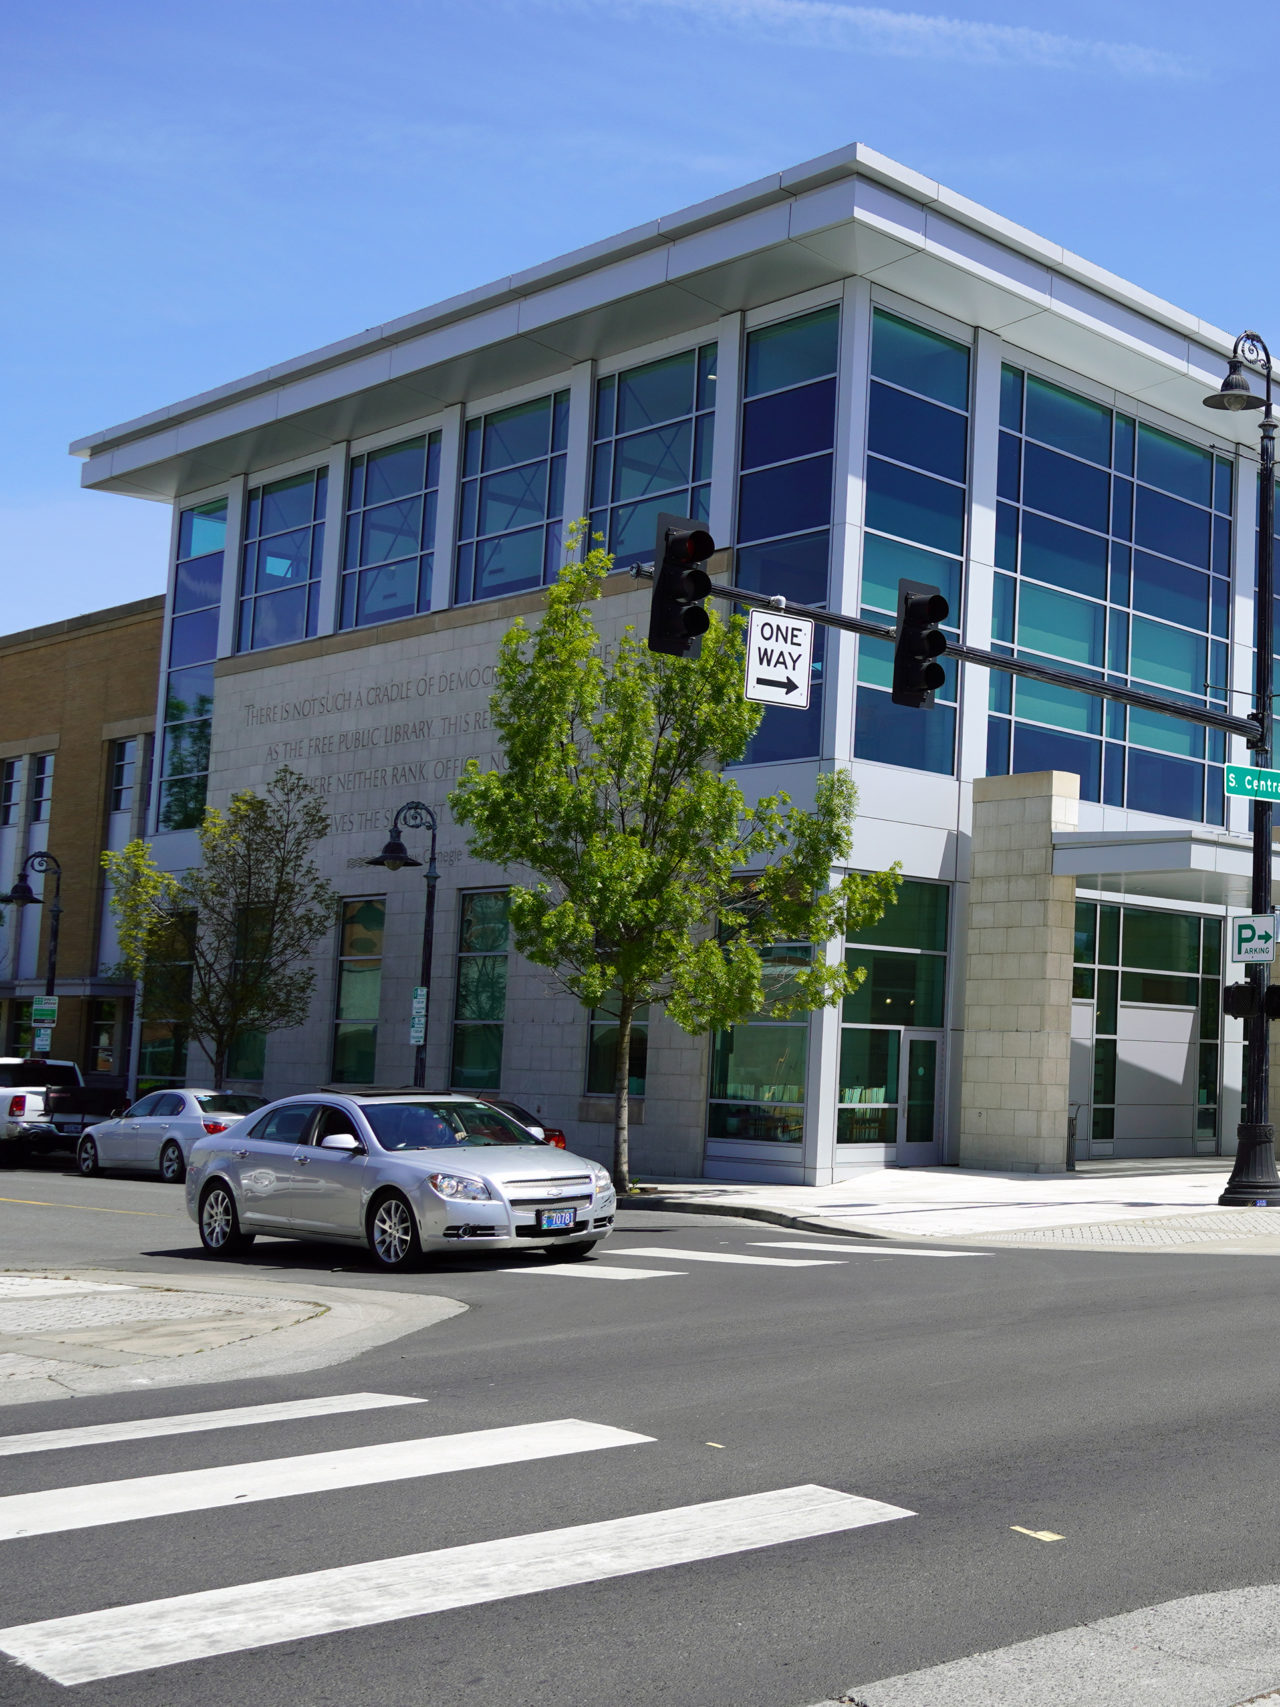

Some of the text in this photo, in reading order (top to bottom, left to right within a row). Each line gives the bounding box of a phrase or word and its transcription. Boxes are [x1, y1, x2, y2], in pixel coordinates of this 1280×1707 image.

[761, 622, 802, 647] ONE
[758, 647, 802, 671] WAY
[244, 704, 278, 728] THERE
[280, 702, 289, 721] IS
[293, 698, 318, 720] NOT
[319, 690, 351, 714] SUCH
[353, 691, 363, 709] A
[366, 680, 412, 707] CRADLE
[416, 674, 435, 697] OF
[438, 664, 499, 693] DEMOCR
[265, 743, 279, 762] AS
[282, 738, 303, 760] THE
[307, 734, 334, 755] FREE
[339, 727, 380, 751] PUBLIC
[440, 714, 469, 736] THIS
[336, 768, 387, 793] NEITHER
[391, 762, 428, 785] RANK,
[1228, 773, 1238, 788] S.
[358, 809, 380, 830] THE
